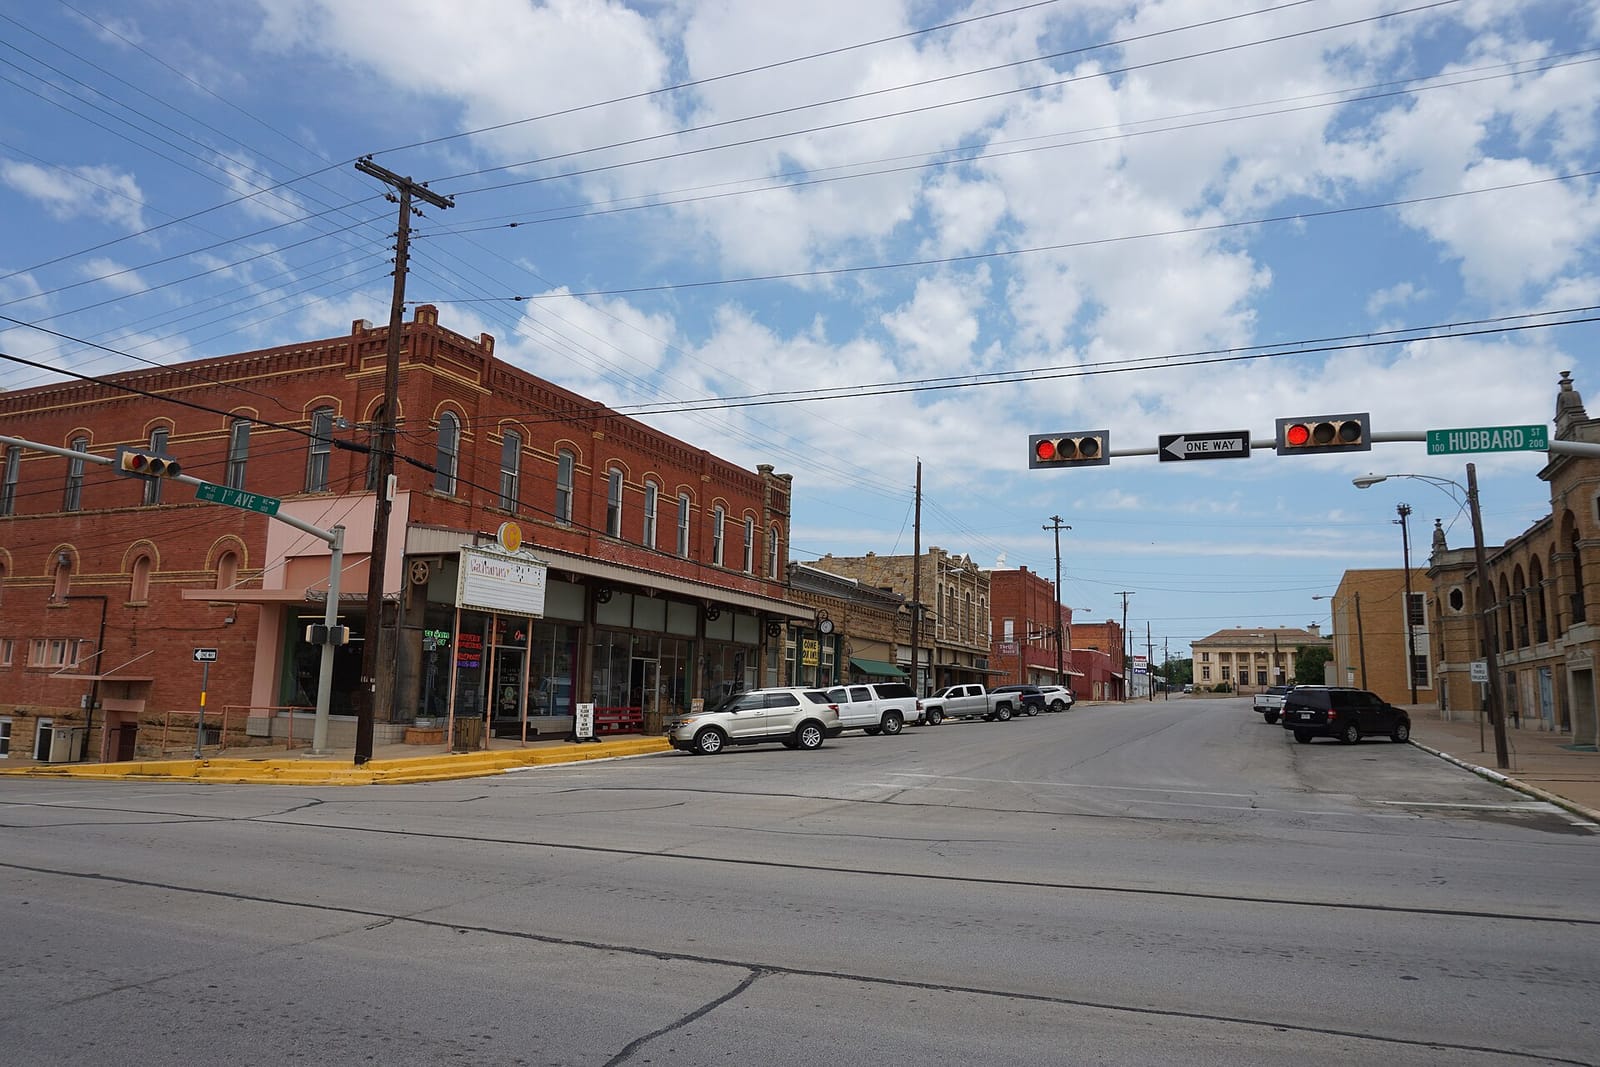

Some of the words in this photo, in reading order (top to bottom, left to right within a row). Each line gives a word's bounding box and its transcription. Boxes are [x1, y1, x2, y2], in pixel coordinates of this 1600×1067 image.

[1531, 428, 1540, 436] ST
[1448, 430, 1524, 450] HUBBARD
[1530, 440, 1544, 448] 200
[1186, 442, 1208, 452] ONE
[1213, 440, 1235, 450] WAY
[1432, 444, 1444, 452] 100
[234, 493, 256, 508] AVE
[507, 528, 516, 548] C
[804, 640, 817, 649] COME
